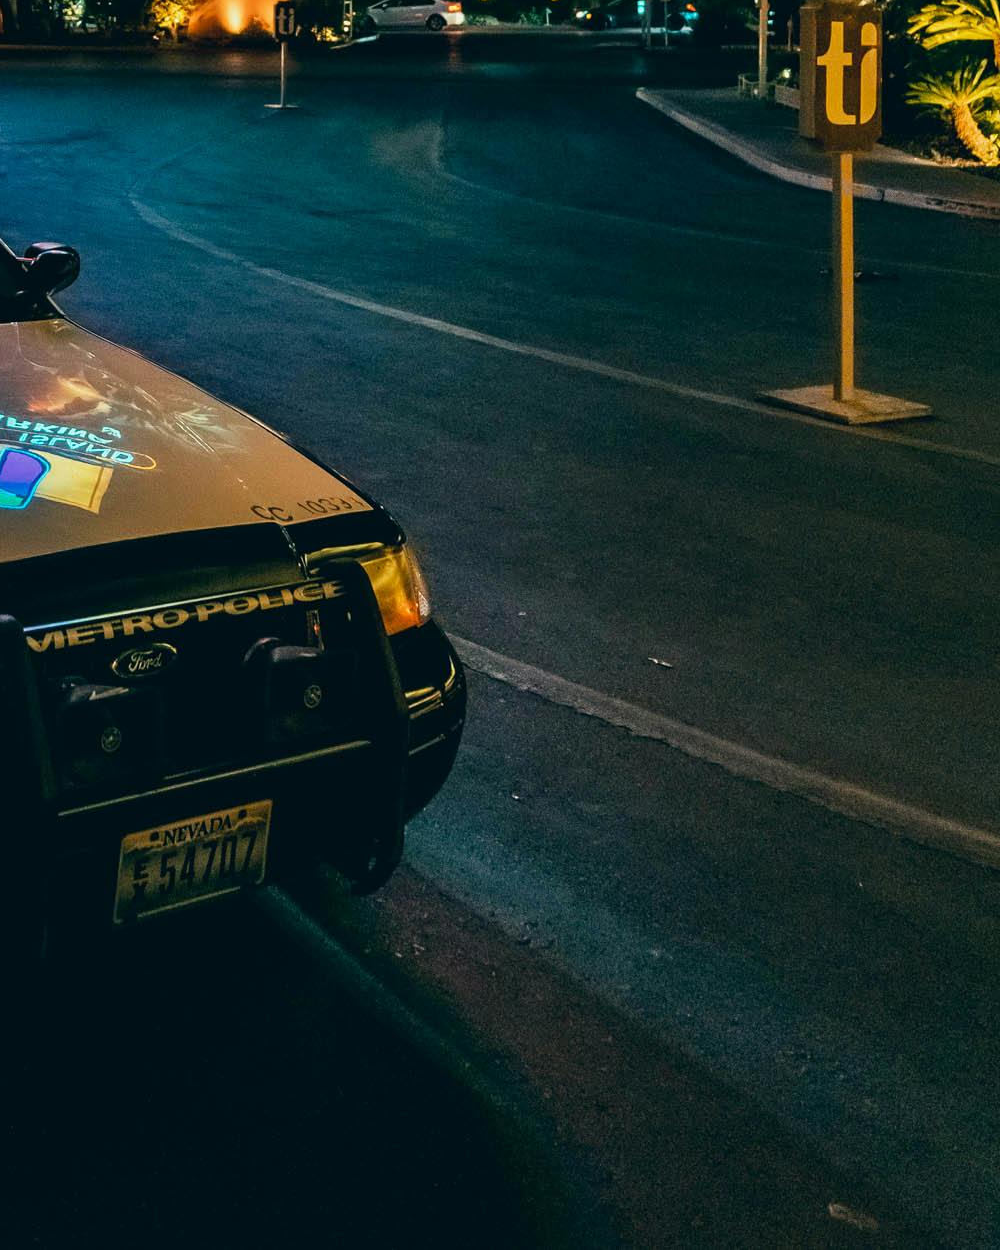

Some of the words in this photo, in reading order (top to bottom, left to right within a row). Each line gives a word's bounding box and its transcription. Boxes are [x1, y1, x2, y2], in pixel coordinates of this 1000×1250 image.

[276, 6, 295, 36] ti
[816, 21, 879, 126] ti
[250, 505, 293, 523] CC
[196, 581, 348, 623] POLICE
[128, 649, 163, 673] Ford
[163, 814, 233, 847] NEVADA
